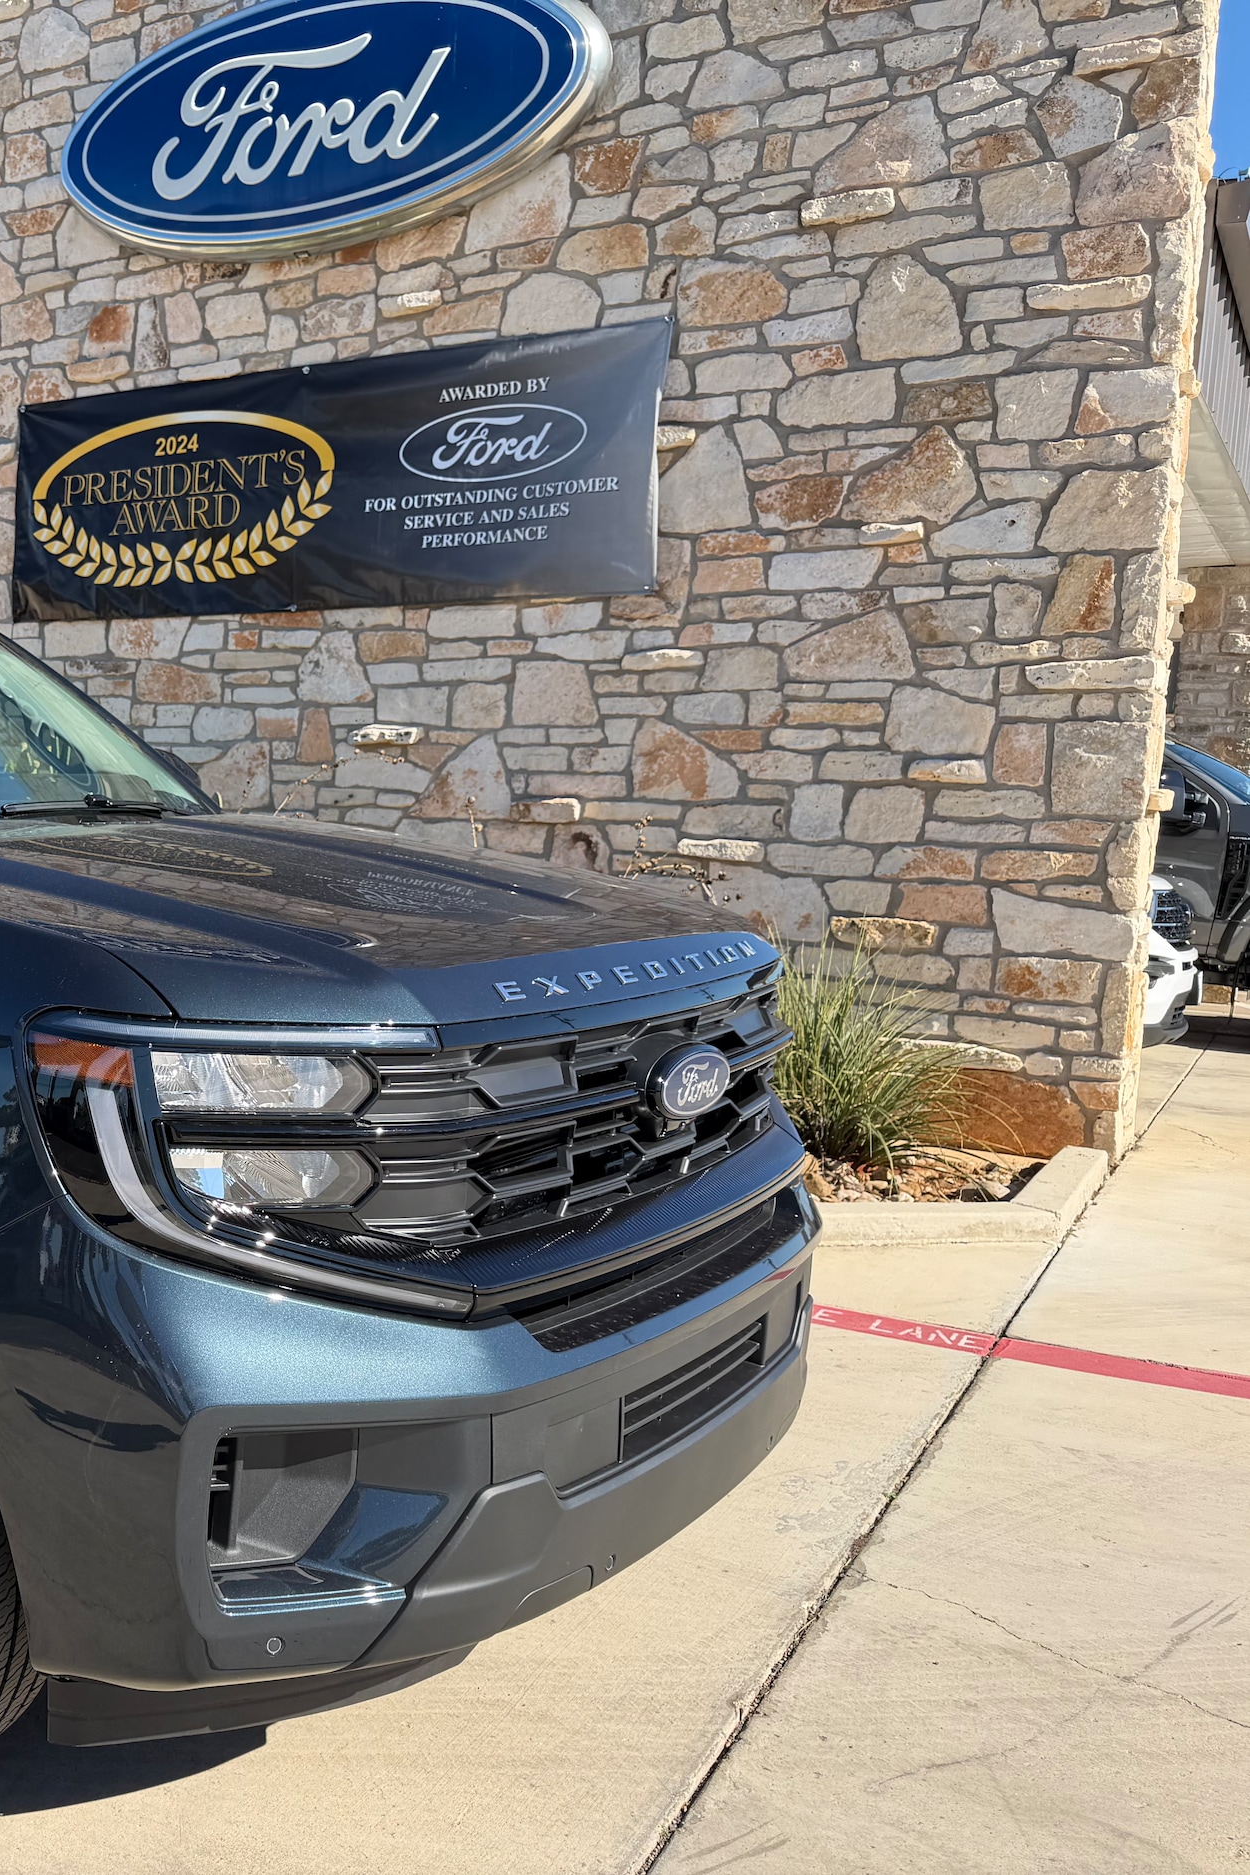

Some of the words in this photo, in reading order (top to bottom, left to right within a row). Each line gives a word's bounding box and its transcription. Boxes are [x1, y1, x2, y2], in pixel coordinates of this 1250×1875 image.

[152, 32, 452, 200] Ford
[438, 380, 522, 403] AWARDED
[526, 376, 551, 393] BY
[154, 433, 199, 457] 2024
[431, 414, 553, 470] Ford
[62, 449, 307, 508] PRESIDENT'S
[364, 497, 397, 513] FOR
[401, 487, 518, 510] OUTSTANDING
[522, 476, 620, 500] CUSTOMER
[108, 493, 242, 537] AWARD
[403, 511, 475, 531] SERVICE
[478, 508, 514, 525] AND
[517, 501, 571, 521] SALES
[421, 525, 549, 549] PERFORMANCE
[492, 939, 758, 1002] EXPEDITION
[678, 1060, 719, 1108] Ford
[868, 1318, 991, 1351] LANE
